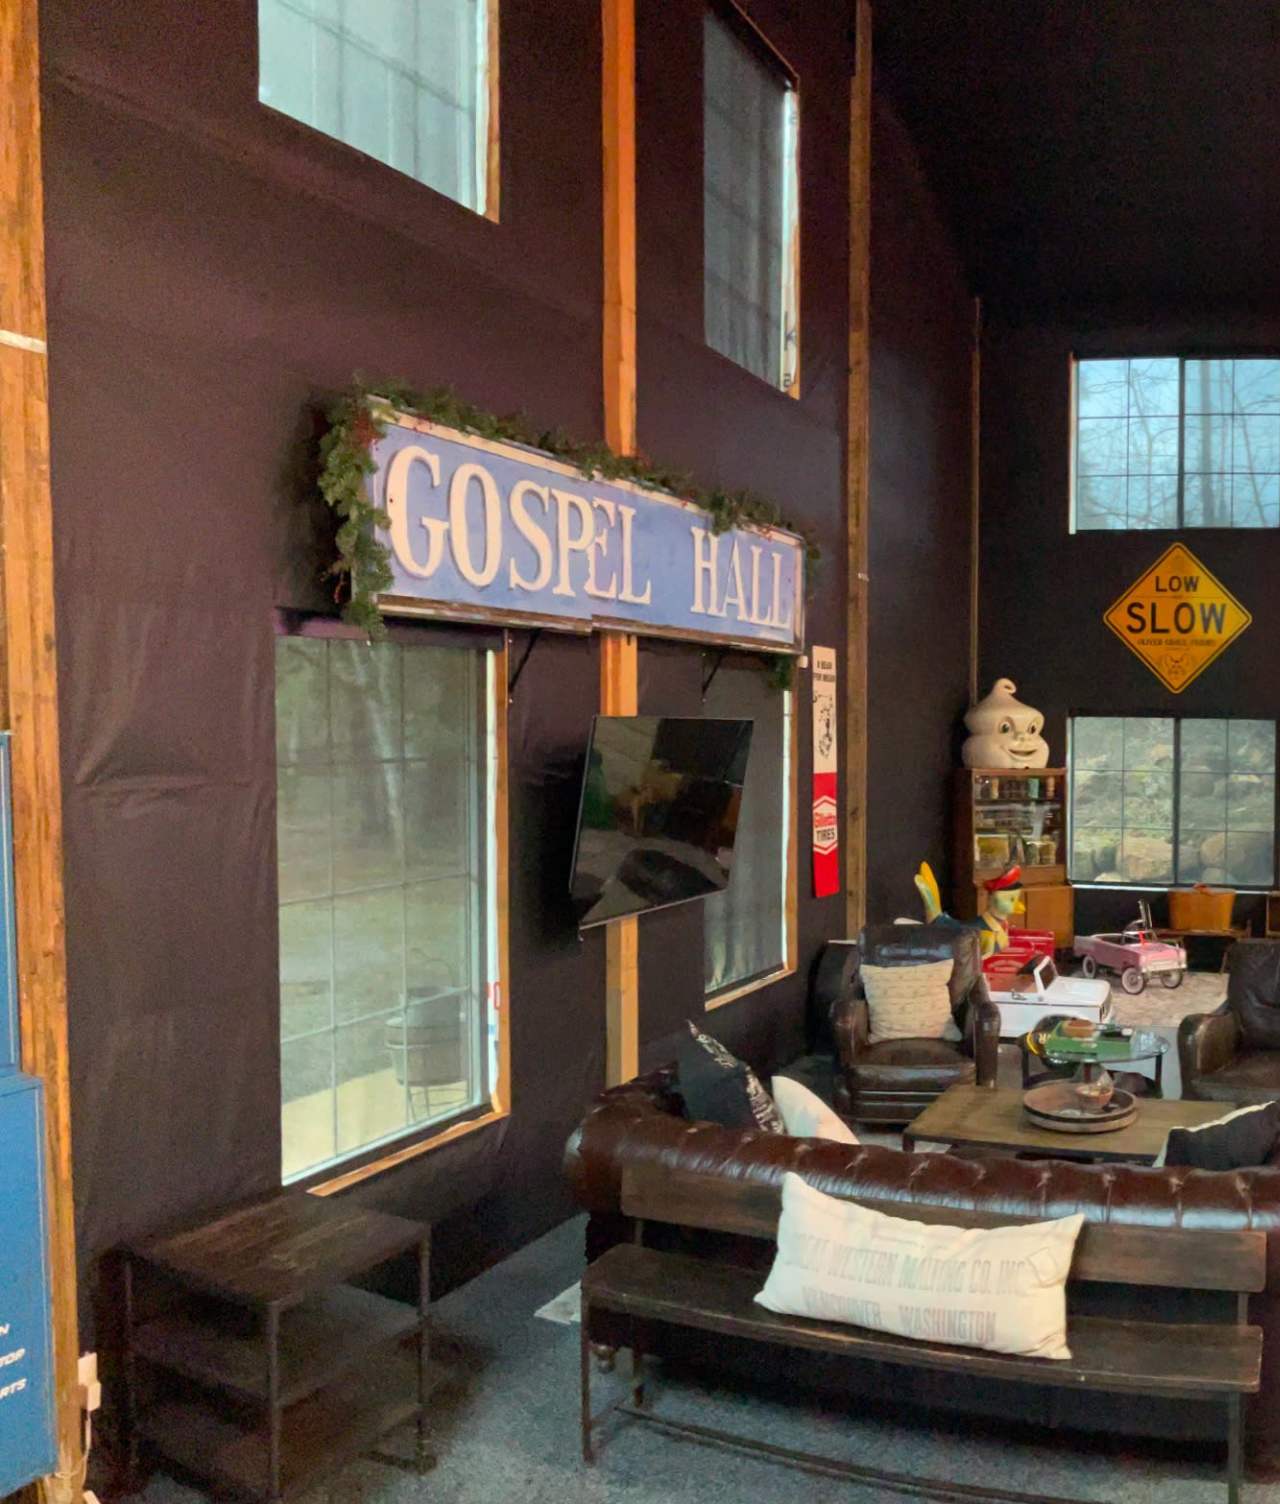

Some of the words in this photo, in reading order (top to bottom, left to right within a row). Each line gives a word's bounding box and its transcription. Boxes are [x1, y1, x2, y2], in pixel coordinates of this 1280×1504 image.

[387, 445, 651, 606] GOSPEL
[689, 524, 794, 631] HALL
[1155, 575, 1200, 593] LOW
[1126, 601, 1227, 635] SLOW
[815, 827, 836, 842] TIRES
[899, 1304, 998, 1345] WASHINGTON
